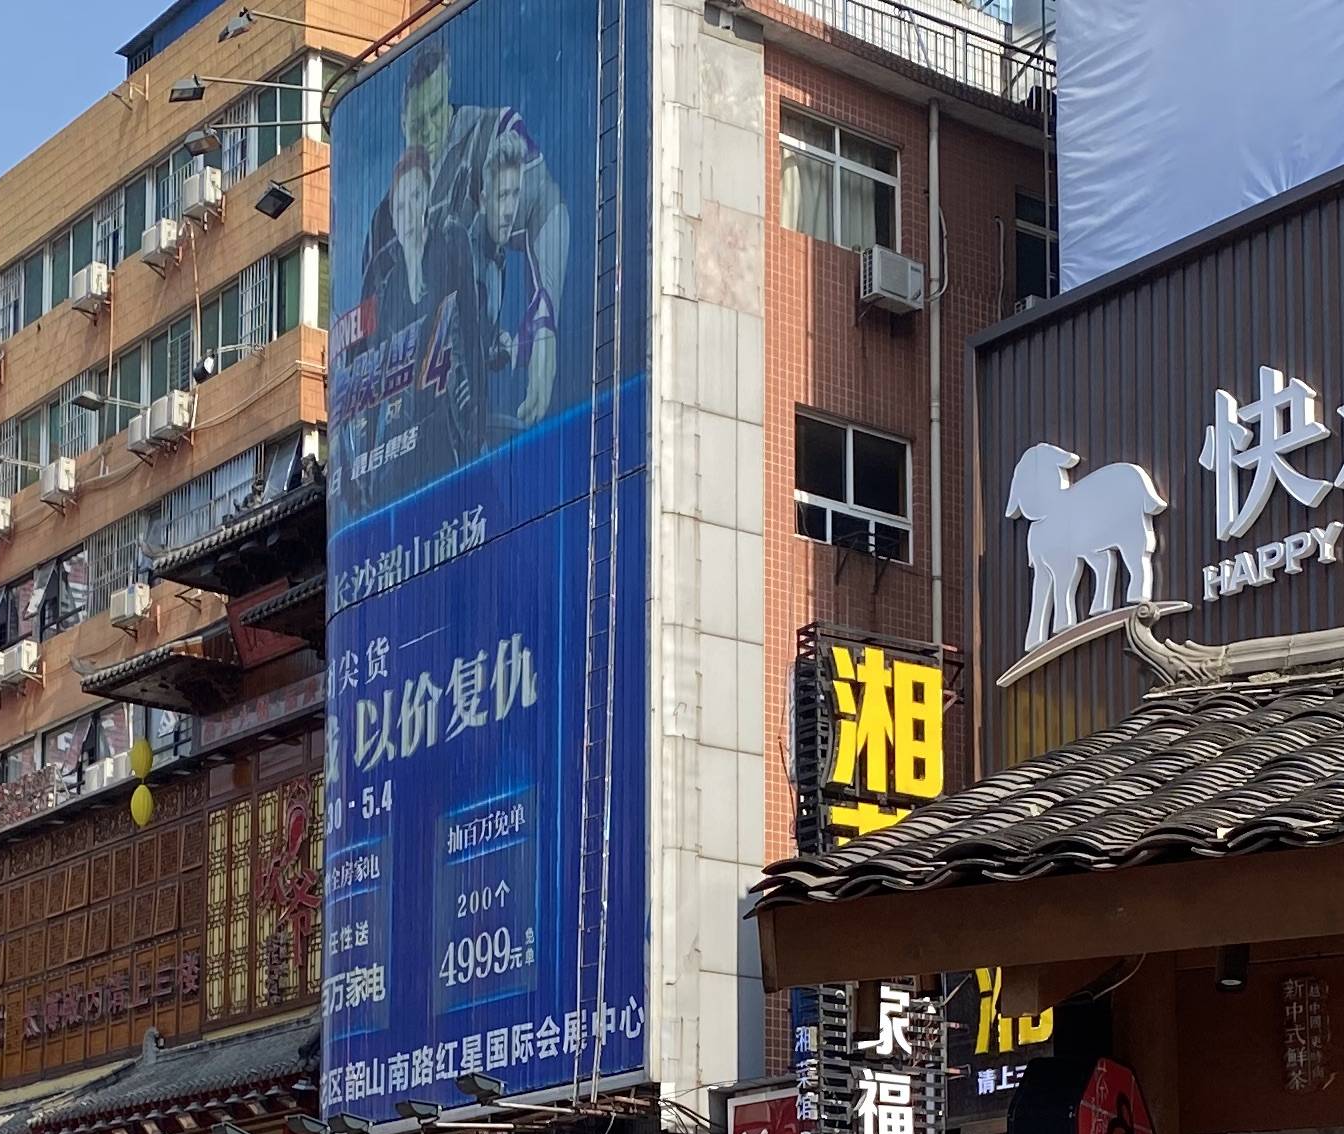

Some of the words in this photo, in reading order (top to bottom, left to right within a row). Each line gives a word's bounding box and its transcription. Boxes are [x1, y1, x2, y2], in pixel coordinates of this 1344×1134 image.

[334, 504, 486, 614] 长沙韶山商场
[1203, 520, 1344, 601] HAPPY
[354, 632, 537, 772] 以价复仇
[447, 803, 526, 855] 抽百万免单
[457, 879, 511, 919] 200个
